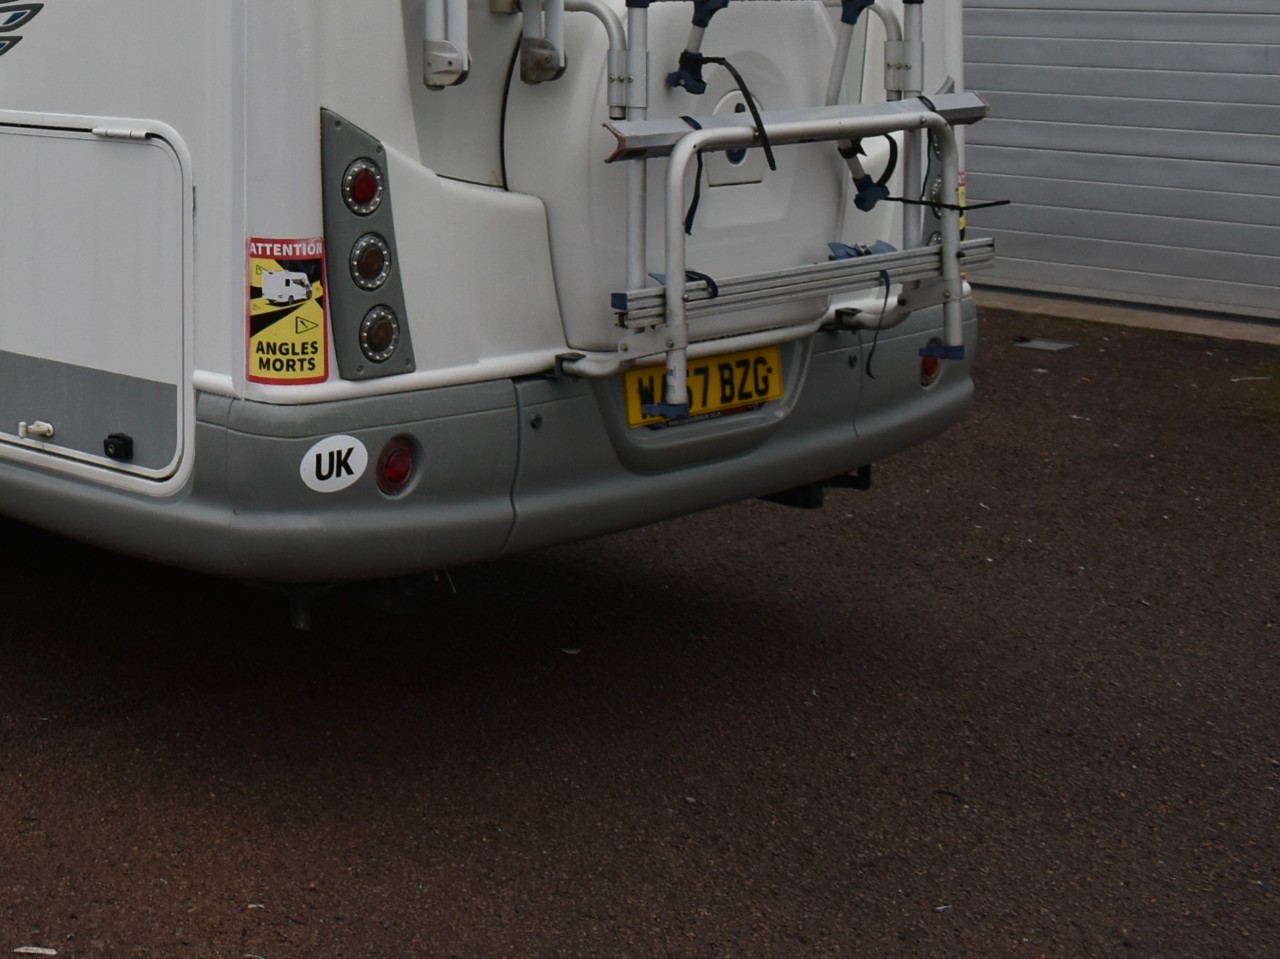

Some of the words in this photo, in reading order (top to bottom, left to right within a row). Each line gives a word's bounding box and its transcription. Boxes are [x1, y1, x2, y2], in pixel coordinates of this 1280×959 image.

[250, 241, 323, 257] ATTENTION
[255, 340, 319, 356] ANGLES
[258, 356, 317, 373] MORTS
[718, 356, 770, 404] BZG
[314, 446, 355, 481] UK
